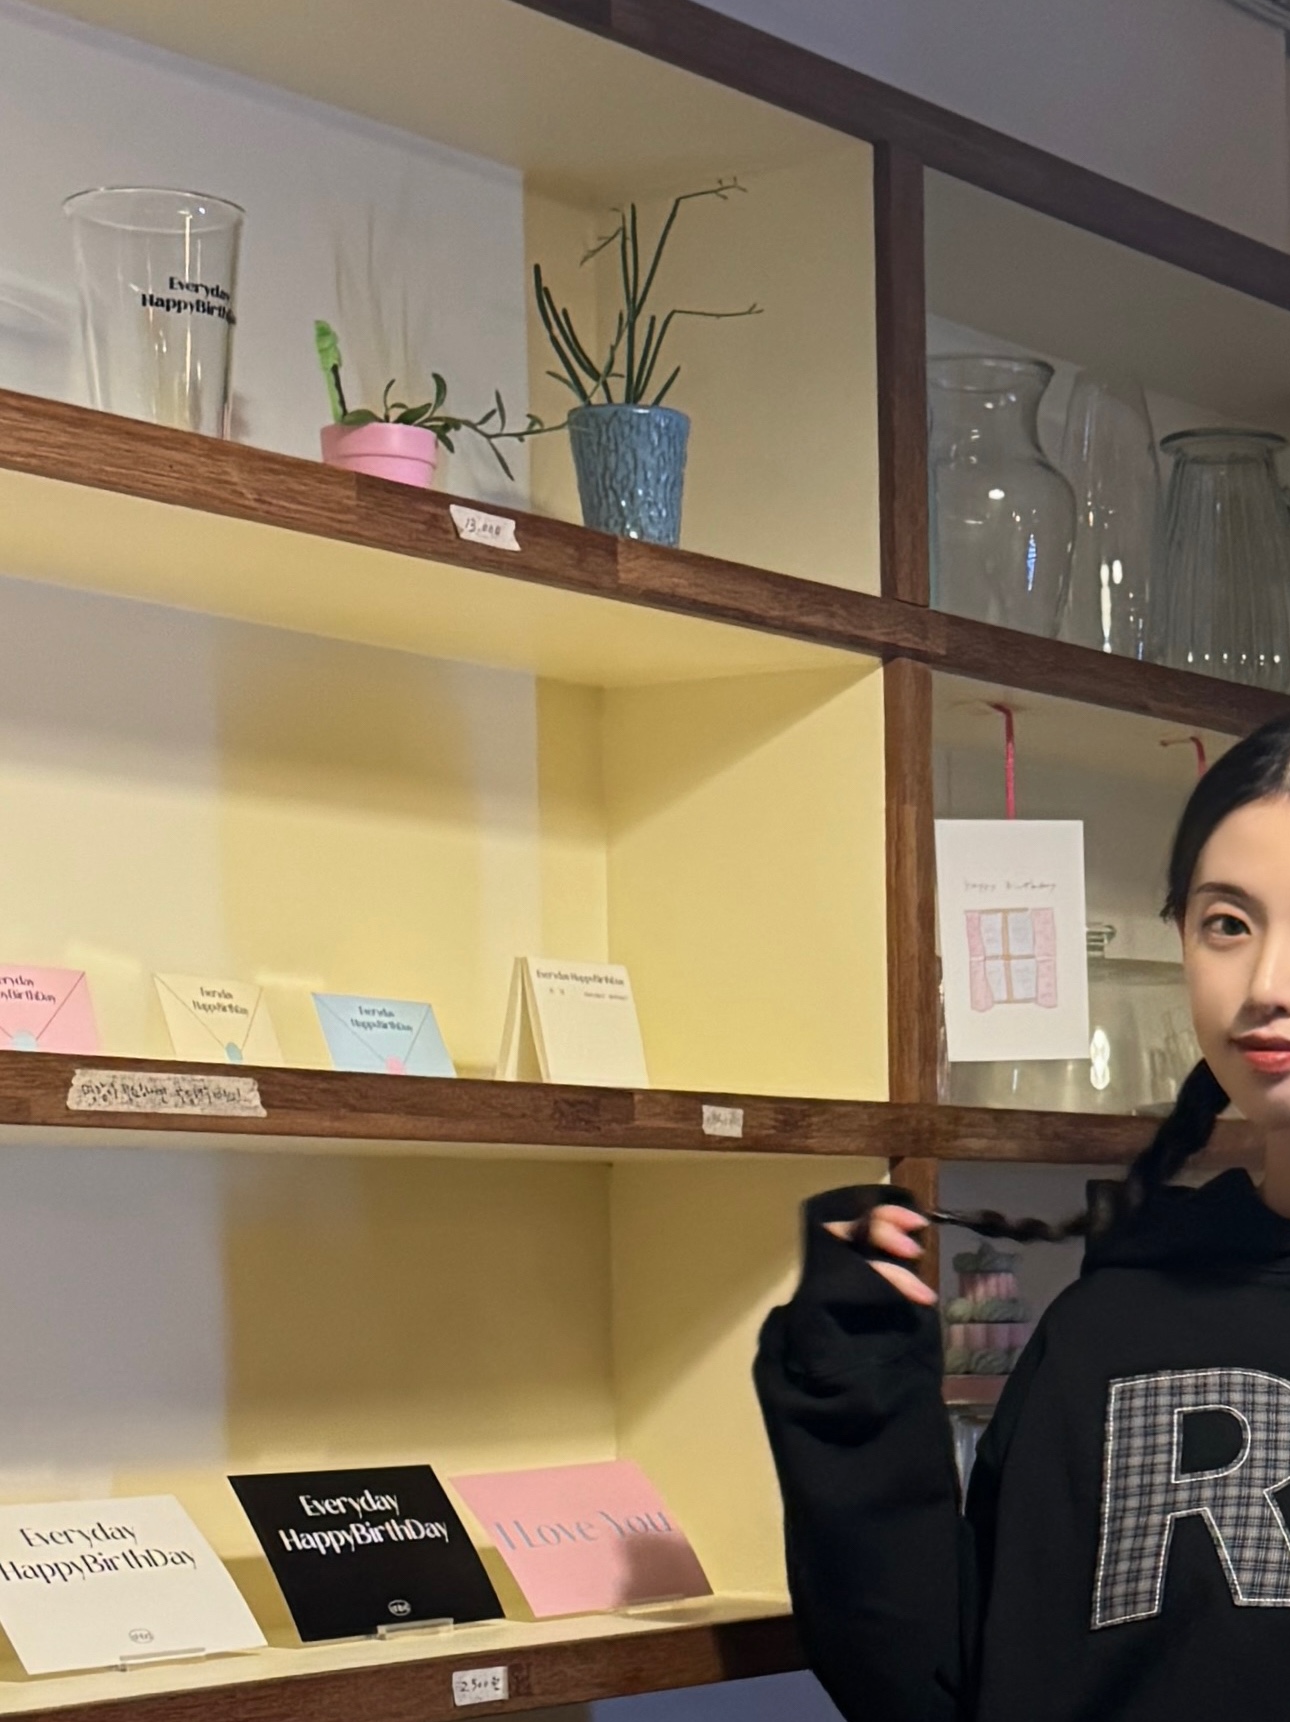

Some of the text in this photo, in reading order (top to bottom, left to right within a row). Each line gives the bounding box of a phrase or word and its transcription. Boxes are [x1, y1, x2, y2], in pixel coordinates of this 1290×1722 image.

[298, 1489, 399, 1519] Everyday
[19, 1521, 138, 1549] Everyday
[278, 1519, 449, 1555] HappyBirthDay
[513, 1519, 599, 1549] Love
[597, 1510, 673, 1540] You
[0, 1548, 197, 1585] HappyBirthDay
